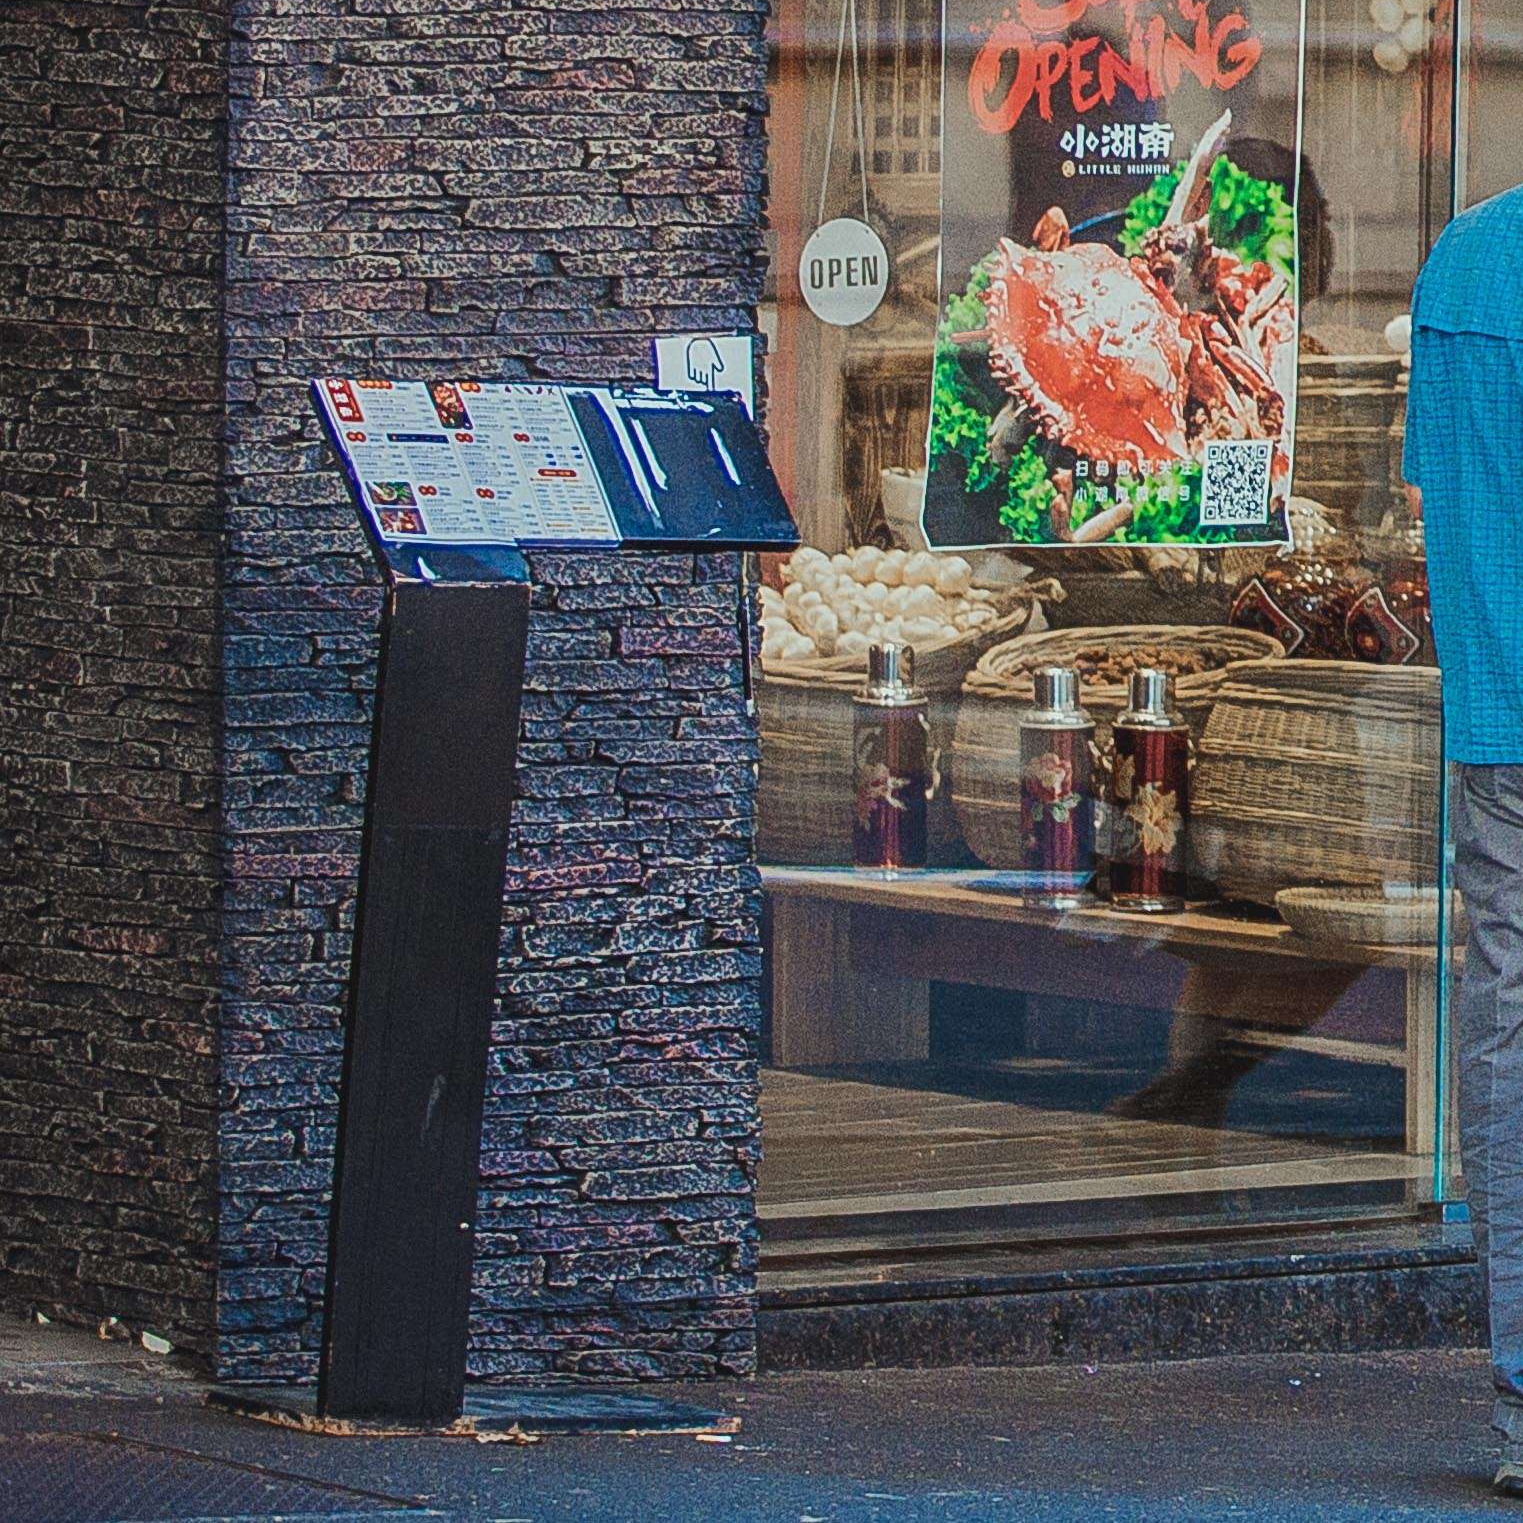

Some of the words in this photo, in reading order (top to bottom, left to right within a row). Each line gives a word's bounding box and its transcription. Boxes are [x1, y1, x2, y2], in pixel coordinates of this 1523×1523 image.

[967, 0, 1262, 133] OPENING
[1060, 122, 1174, 159] 小湖南
[1079, 164, 1121, 174] LITTLE
[1127, 164, 1170, 174] HUNAN
[809, 255, 879, 290] OPEN
